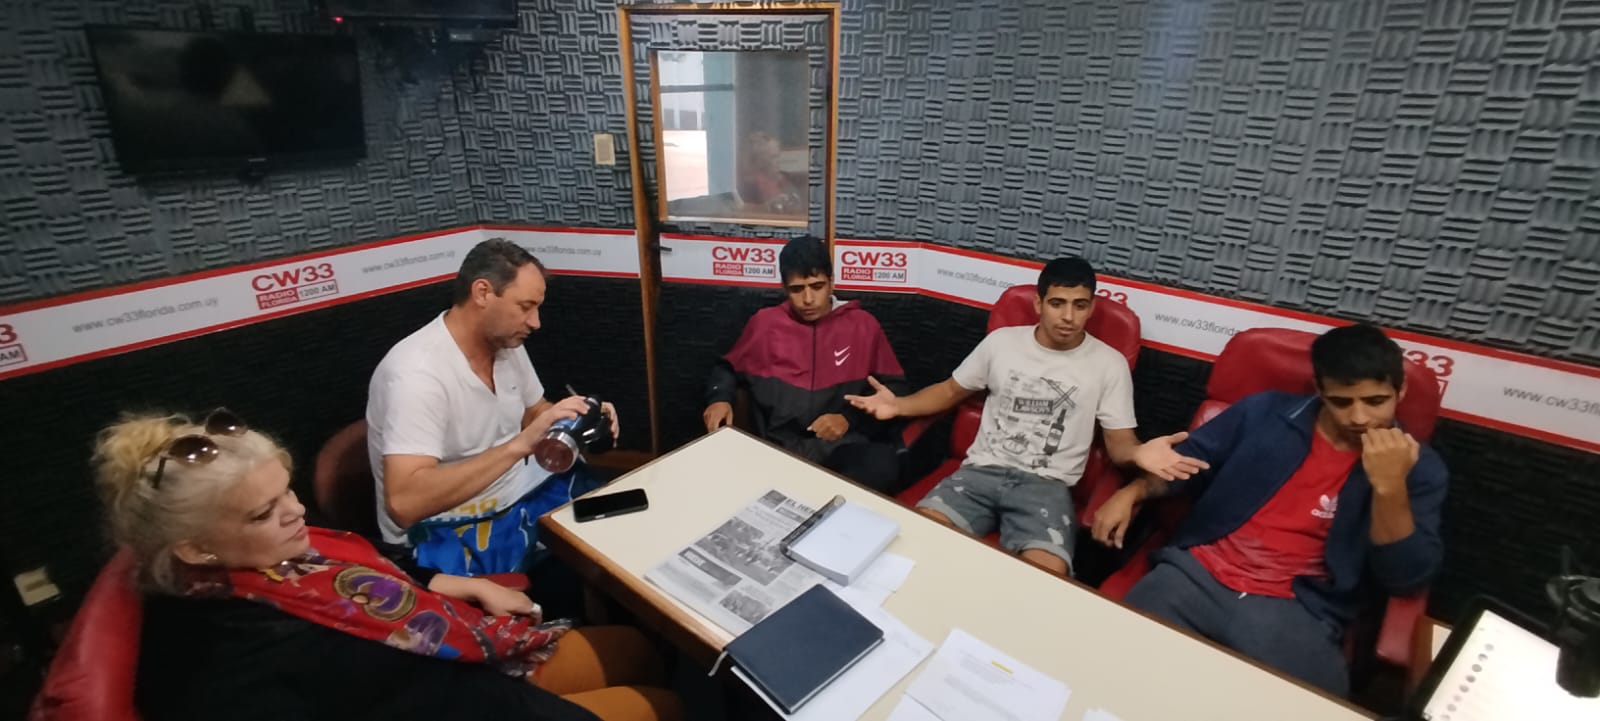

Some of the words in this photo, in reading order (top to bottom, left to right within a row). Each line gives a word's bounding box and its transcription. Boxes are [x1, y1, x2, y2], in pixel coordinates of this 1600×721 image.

[712, 246, 776, 263] CW33
[841, 251, 907, 267] CW33
[252, 263, 334, 291] CW33
[745, 267, 760, 275] 1200
[874, 271, 890, 279] 1200
[259, 289, 295, 301] RADIO
[300, 287, 319, 297] 1200
[321, 284, 336, 293] AM
[261, 296, 298, 308] FLORIDA
[72, 297, 218, 333] www.cw33florida.com.uy
